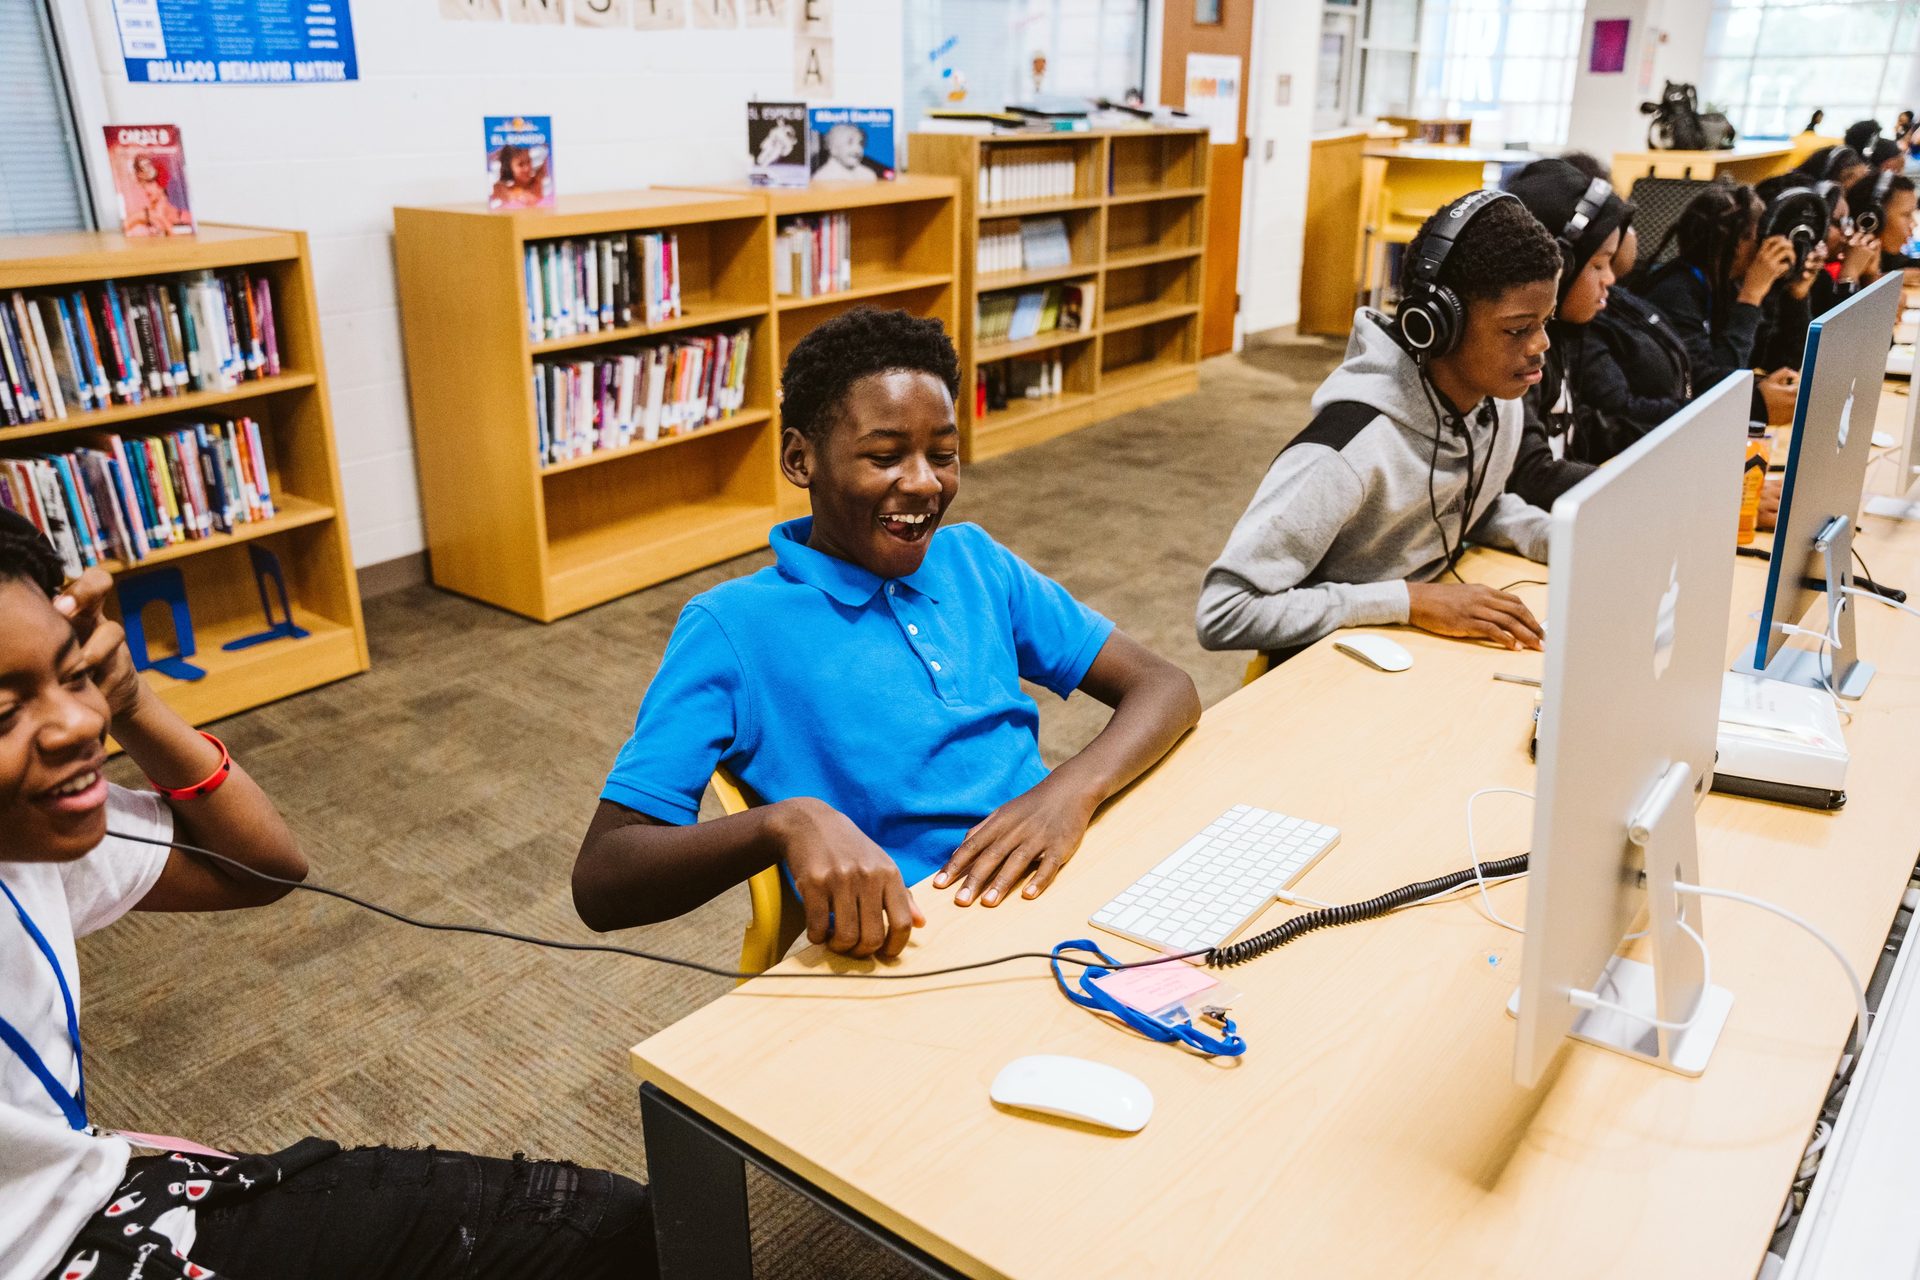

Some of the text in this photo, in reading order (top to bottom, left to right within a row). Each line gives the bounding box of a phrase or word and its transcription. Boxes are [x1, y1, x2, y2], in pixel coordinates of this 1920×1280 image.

[147, 60, 346, 81] BULLDOG BEHAVIOR MATRIX
